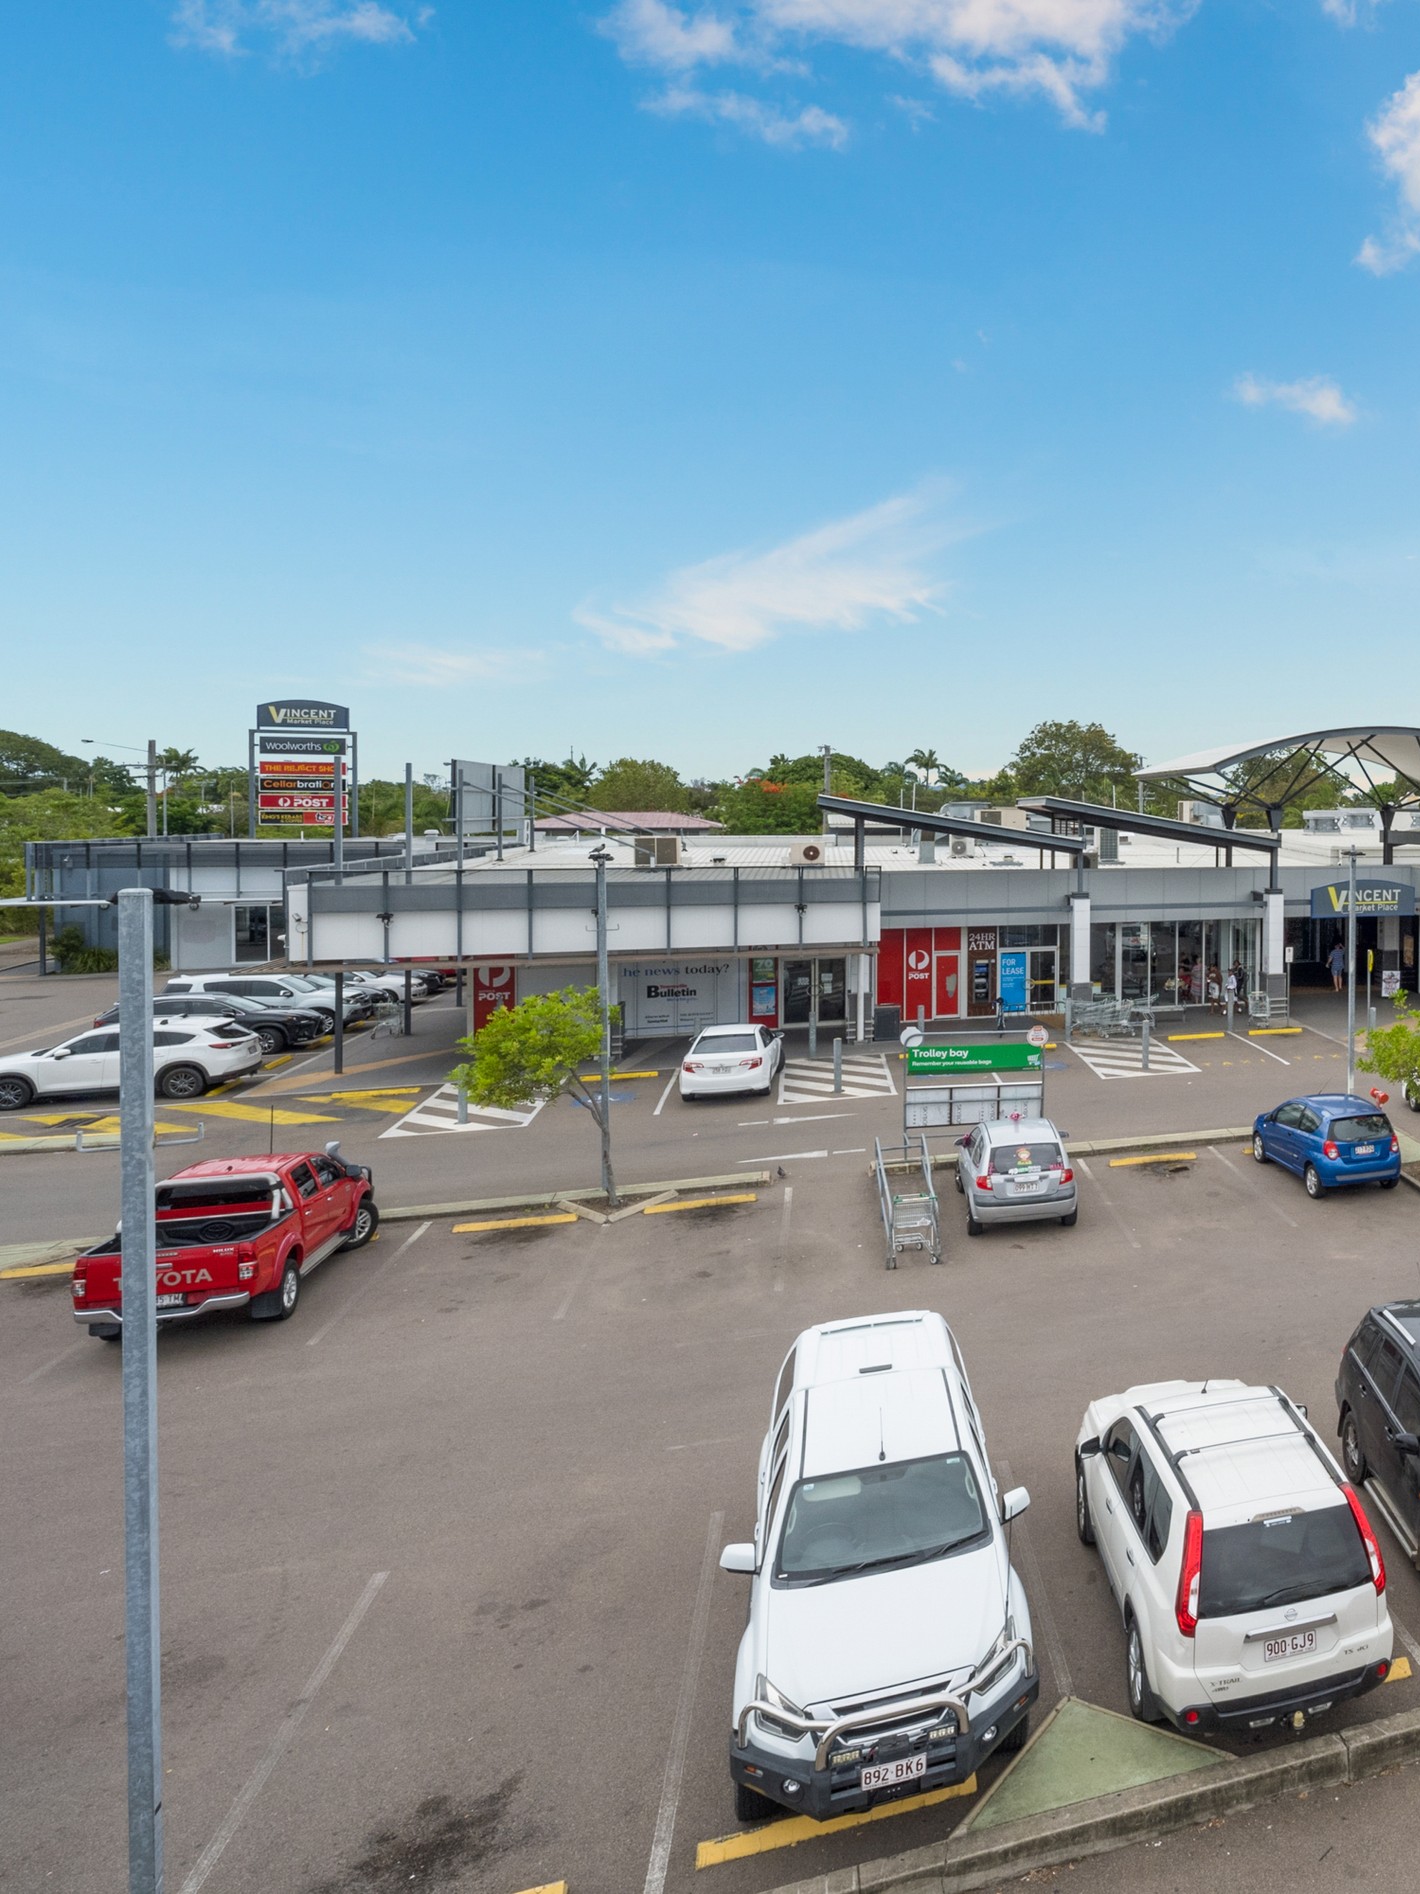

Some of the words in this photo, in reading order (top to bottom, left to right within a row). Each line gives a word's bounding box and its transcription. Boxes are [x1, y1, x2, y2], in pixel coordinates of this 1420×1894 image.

[268, 706, 336, 723] VINCENT
[265, 742, 322, 751] Woolworths
[293, 799, 329, 807] POST
[1328, 886, 1401, 911] VNCENT
[1377, 903, 1399, 911] Place
[969, 933, 995, 941] 24HR
[968, 941, 995, 950] ATM
[644, 967, 680, 977] news
[685, 964, 730, 976] today?
[1002, 967, 1025, 975] LEASE
[908, 972, 930, 980] POST
[478, 991, 511, 1001] POST
[647, 985, 697, 998] Bulletin
[912, 1049, 948, 1060] Trolley
[949, 1048, 969, 1059] bay
[113, 1268, 213, 1291] TOTA
